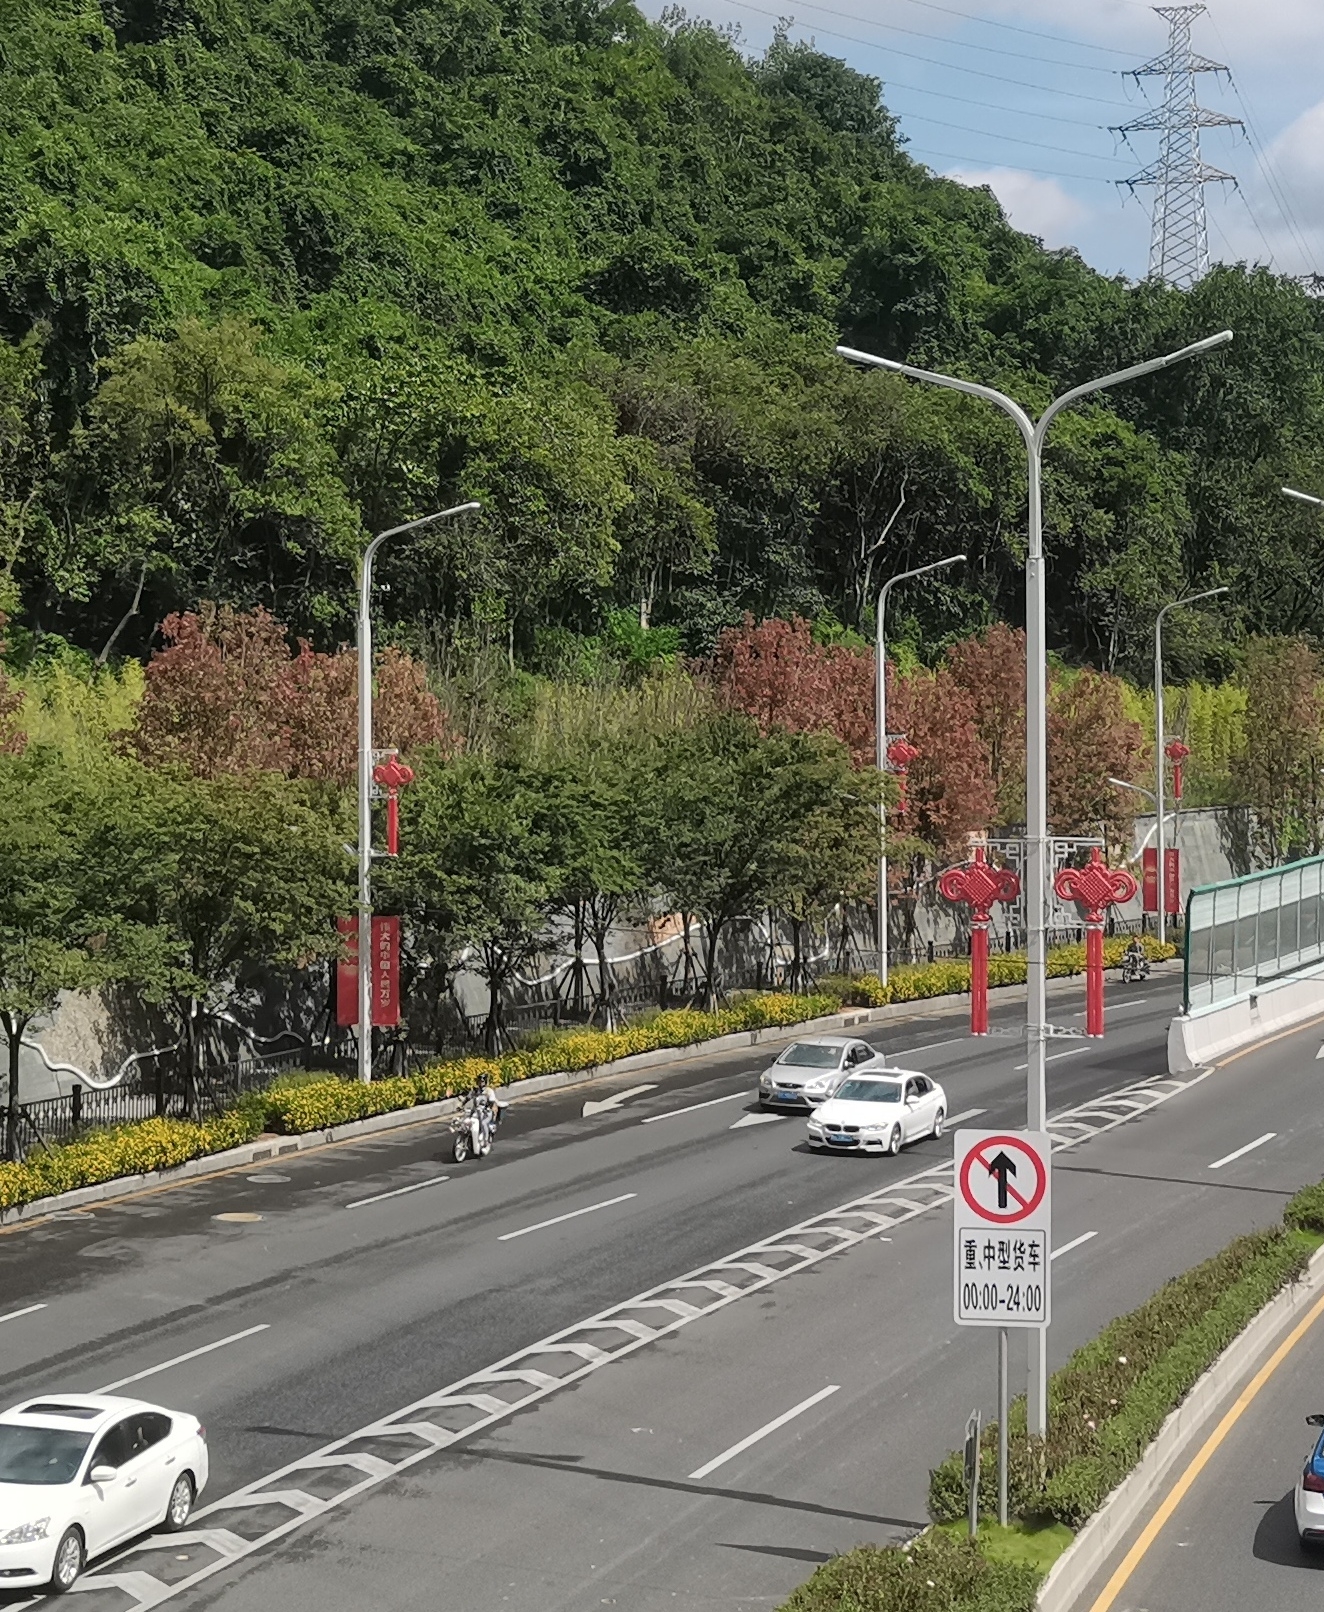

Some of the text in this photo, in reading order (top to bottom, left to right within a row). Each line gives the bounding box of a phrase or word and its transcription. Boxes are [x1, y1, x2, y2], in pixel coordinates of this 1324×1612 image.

[963, 1238, 1041, 1272] 重、中型货车
[963, 1282, 1042, 1312] 00:00-24:00
